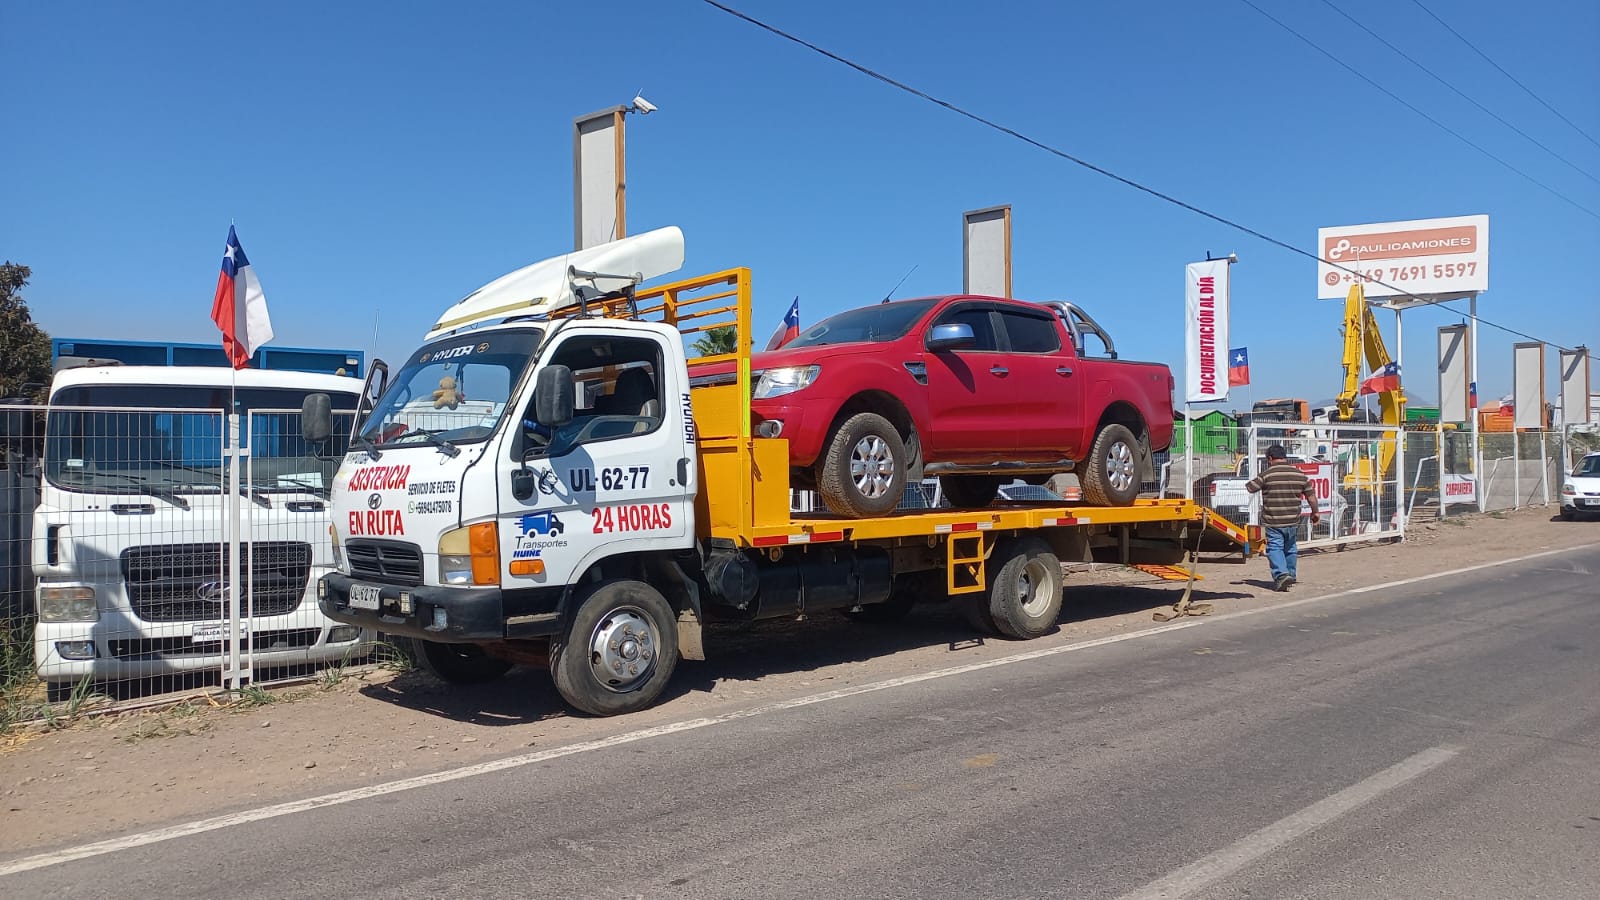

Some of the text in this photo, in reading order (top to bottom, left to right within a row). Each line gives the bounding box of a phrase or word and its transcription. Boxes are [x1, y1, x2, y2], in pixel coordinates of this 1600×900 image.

[1350, 237, 1471, 254] PAULICAMIONES
[1389, 265, 1426, 282] 7691
[1433, 262, 1477, 279] 5597
[1196, 276, 1215, 394] DOCUMENTACIÓN AL DÍA
[682, 393, 695, 444] HYUNDAI
[348, 464, 411, 492] ASISTENCIA
[408, 480, 456, 495] SERVICIO DE FLETES
[349, 510, 404, 535] EN RUTA
[592, 504, 672, 534] 24 HORAS
[515, 536, 567, 550] Transportes
